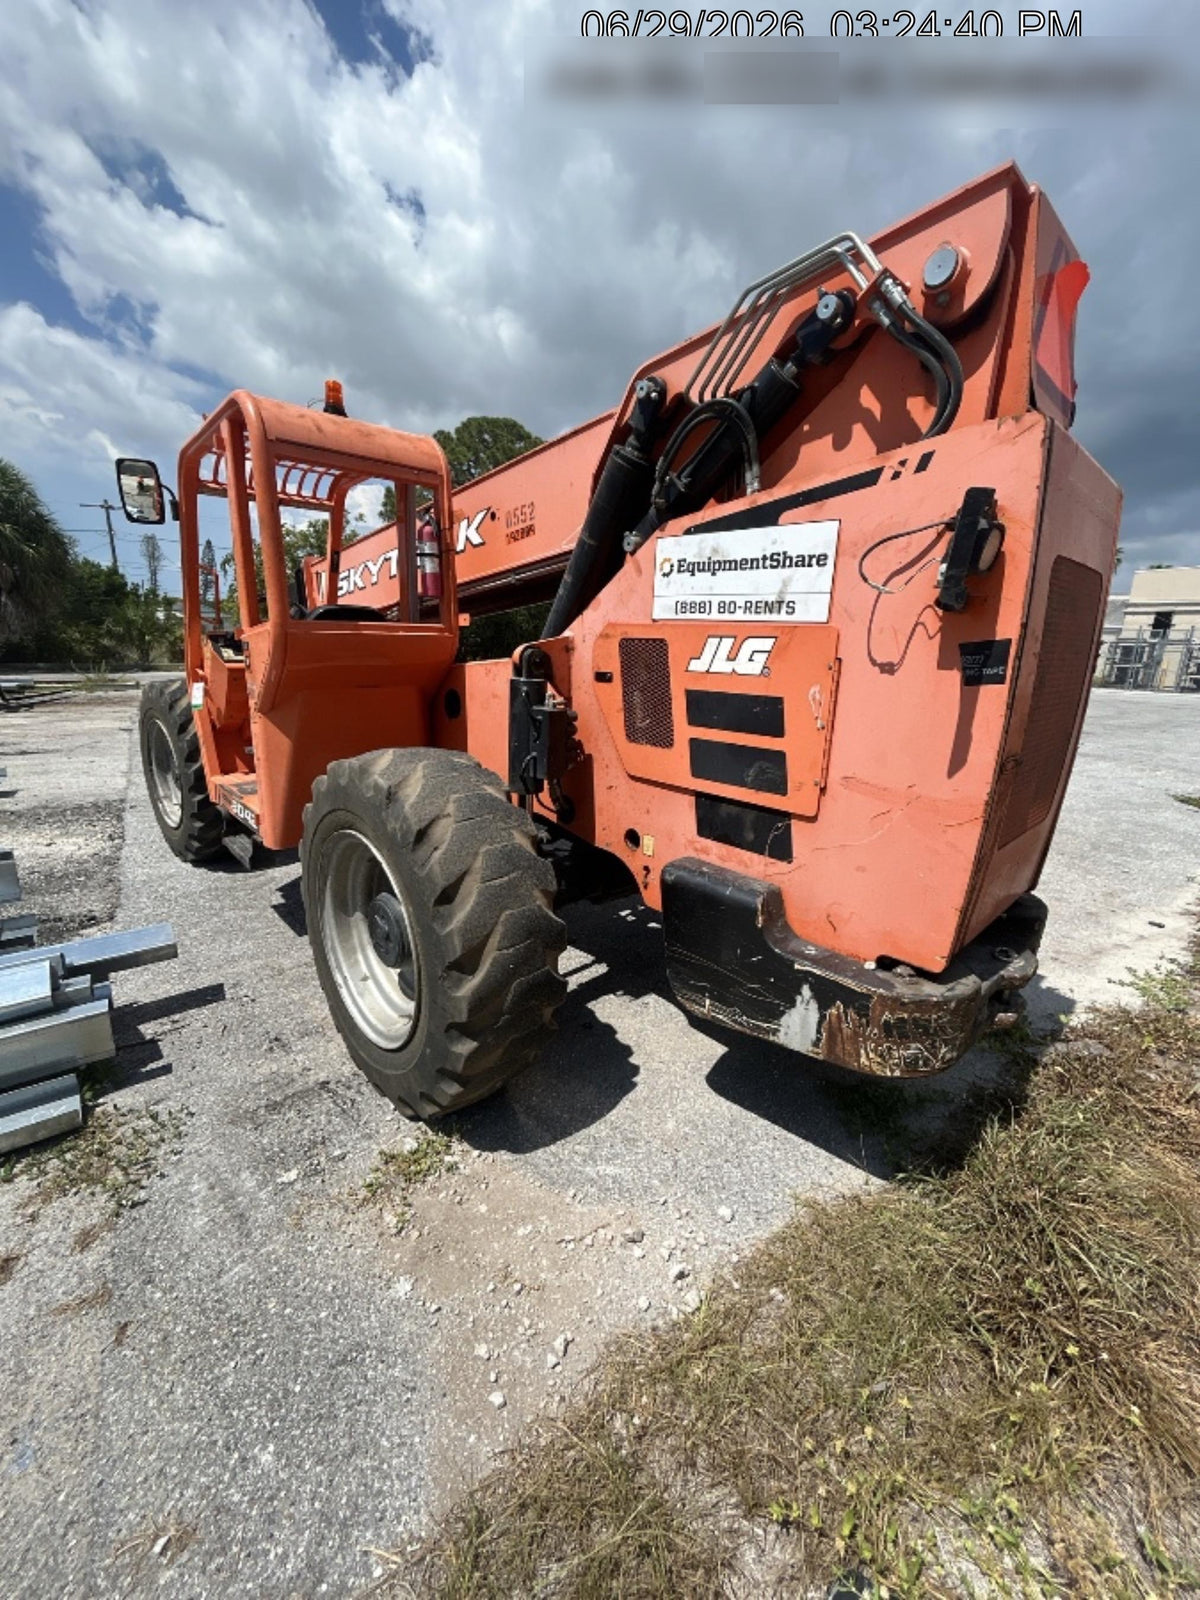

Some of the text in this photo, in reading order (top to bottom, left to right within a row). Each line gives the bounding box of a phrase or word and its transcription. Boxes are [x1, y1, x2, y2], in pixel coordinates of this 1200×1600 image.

[338, 506, 492, 597] SKYTK
[677, 551, 829, 577] EquipmentShare
[675, 600, 797, 616] (888) 80-RENTS
[685, 635, 778, 676] JLG
